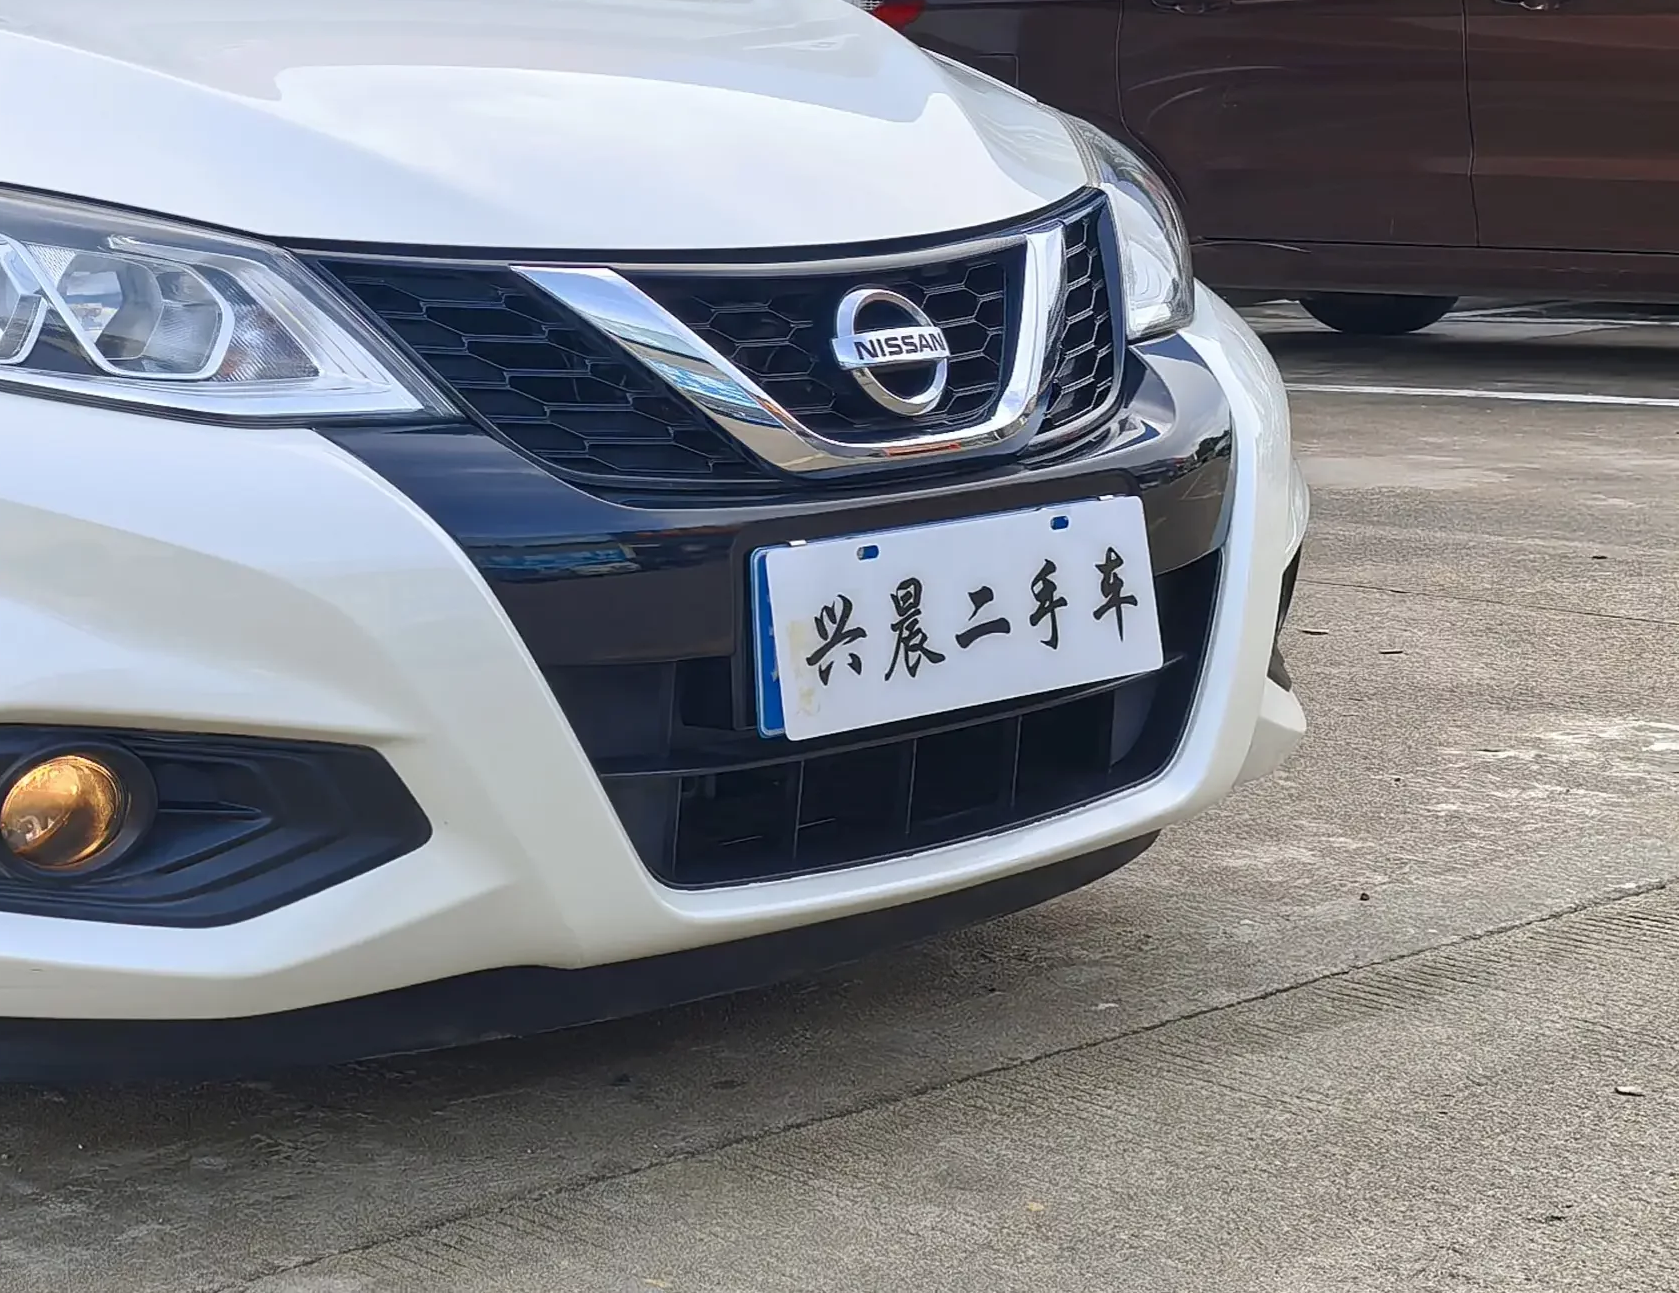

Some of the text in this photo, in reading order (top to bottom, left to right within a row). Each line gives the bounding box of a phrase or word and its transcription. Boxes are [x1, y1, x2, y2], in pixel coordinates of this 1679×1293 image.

[853, 332, 947, 360] NISSAN
[806, 546, 1138, 686] 兴晨二手车
